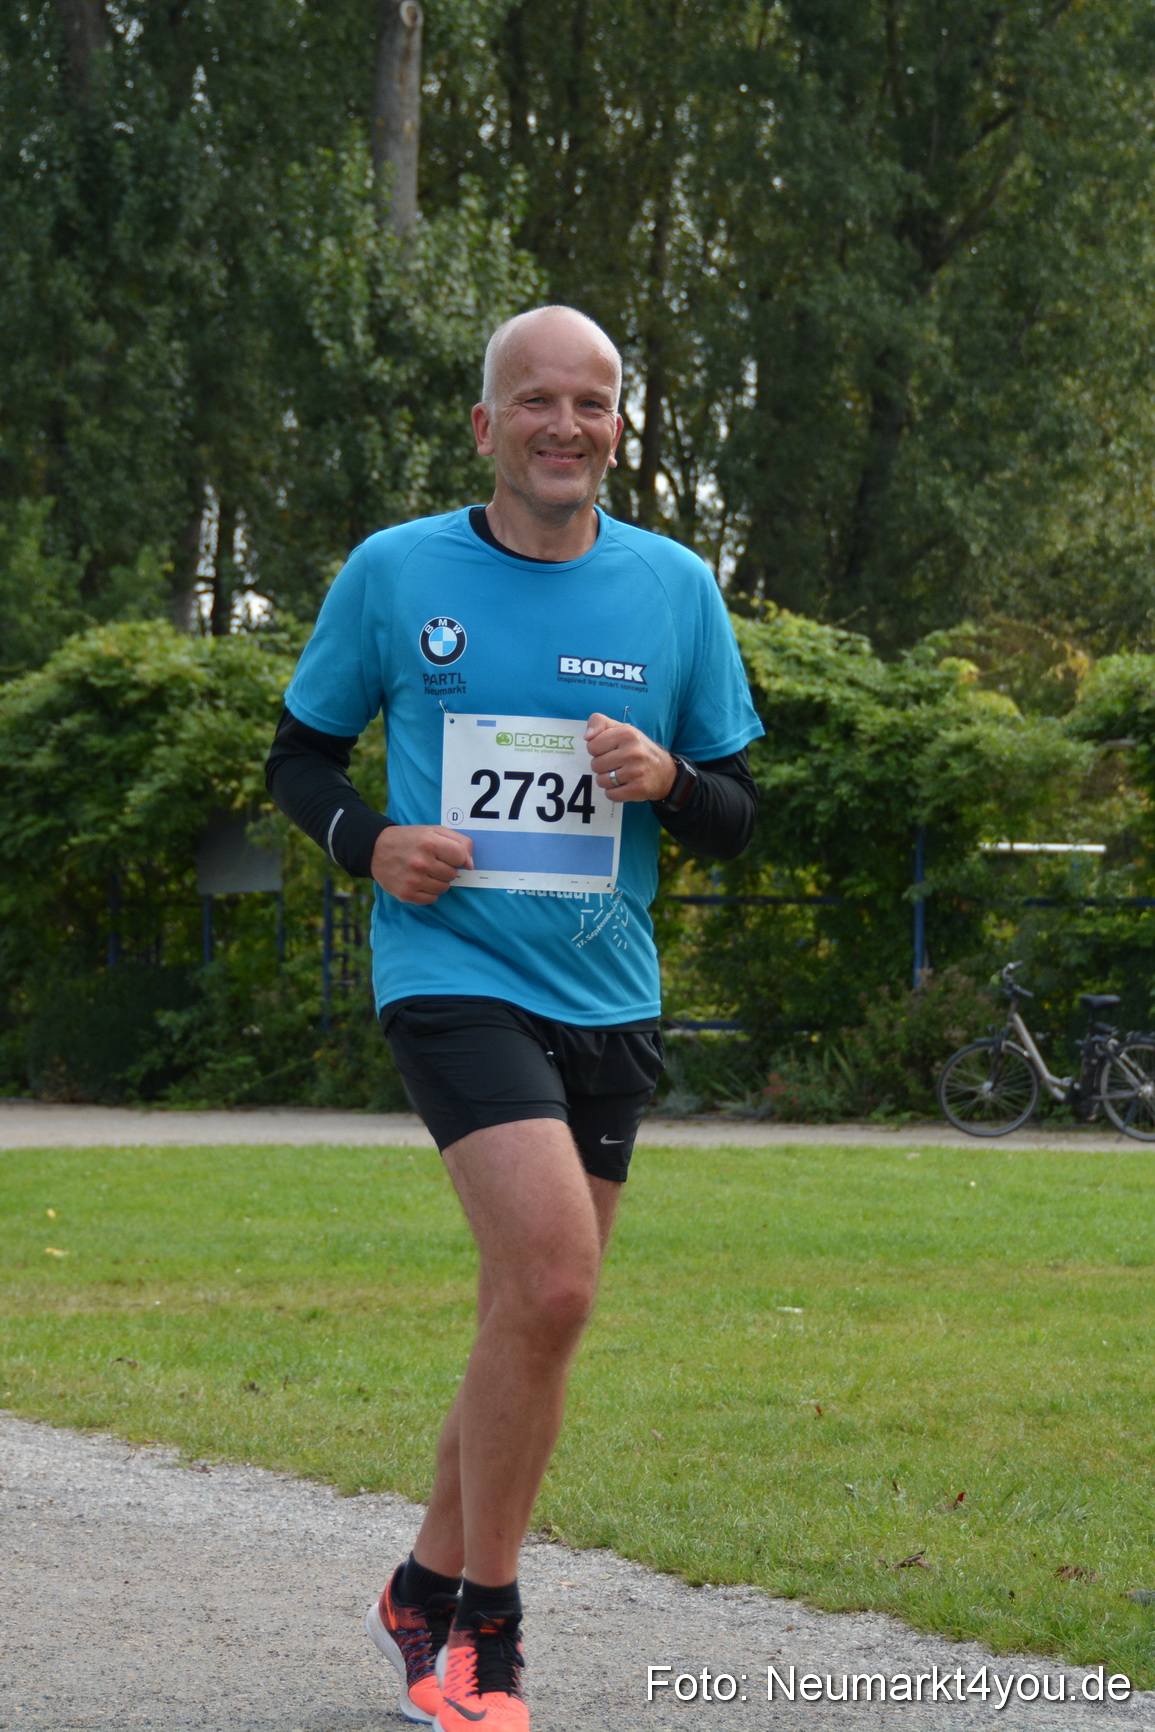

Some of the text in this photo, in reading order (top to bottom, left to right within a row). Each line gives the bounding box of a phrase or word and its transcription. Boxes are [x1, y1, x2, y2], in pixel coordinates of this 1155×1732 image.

[424, 618, 463, 635] BMW
[559, 657, 645, 683] BOCK
[422, 673, 467, 686] PARTL
[557, 676, 649, 694] inspired by smart concepts
[424, 685, 467, 696] Neumarkt
[515, 733, 575, 750] BOCK
[469, 769, 596, 825] 2734
[451, 812, 459, 822] D
